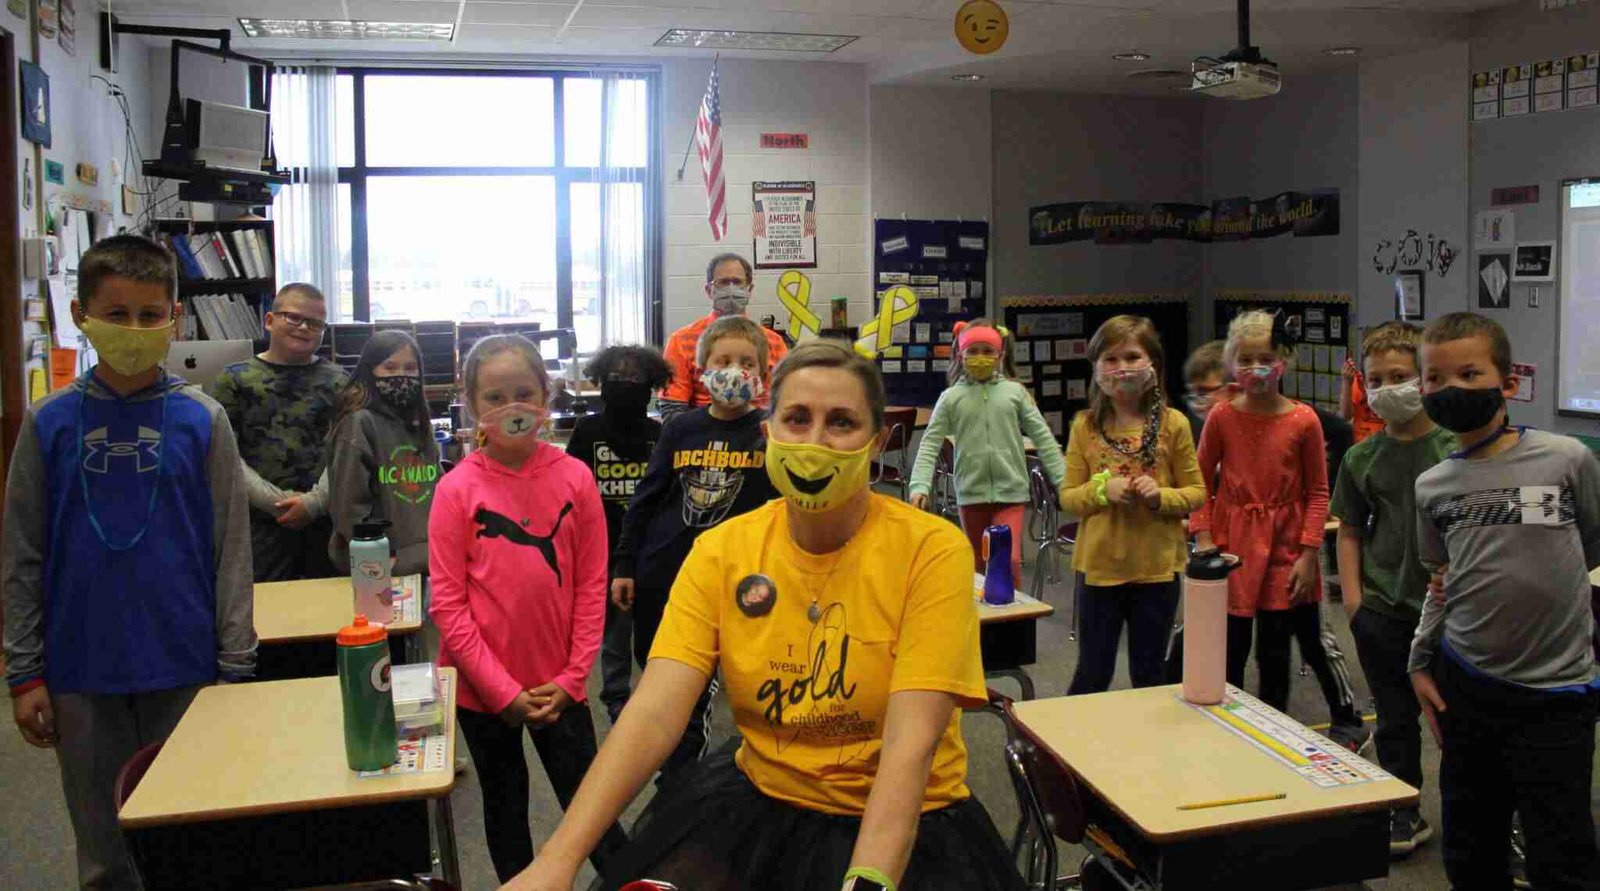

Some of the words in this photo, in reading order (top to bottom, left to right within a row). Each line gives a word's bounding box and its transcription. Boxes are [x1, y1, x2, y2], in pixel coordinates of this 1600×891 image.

[763, 134, 804, 147] North
[769, 214, 801, 224] AMERICA
[1047, 215, 1073, 234] Let
[1077, 208, 1146, 230] learning
[1255, 211, 1278, 231] the
[673, 449, 765, 470] ARCHBOLD
[786, 644, 796, 658] I
[769, 660, 807, 675] wear
[756, 634, 858, 726] gold
[829, 702, 846, 714] for
[791, 710, 862, 727] childhood
